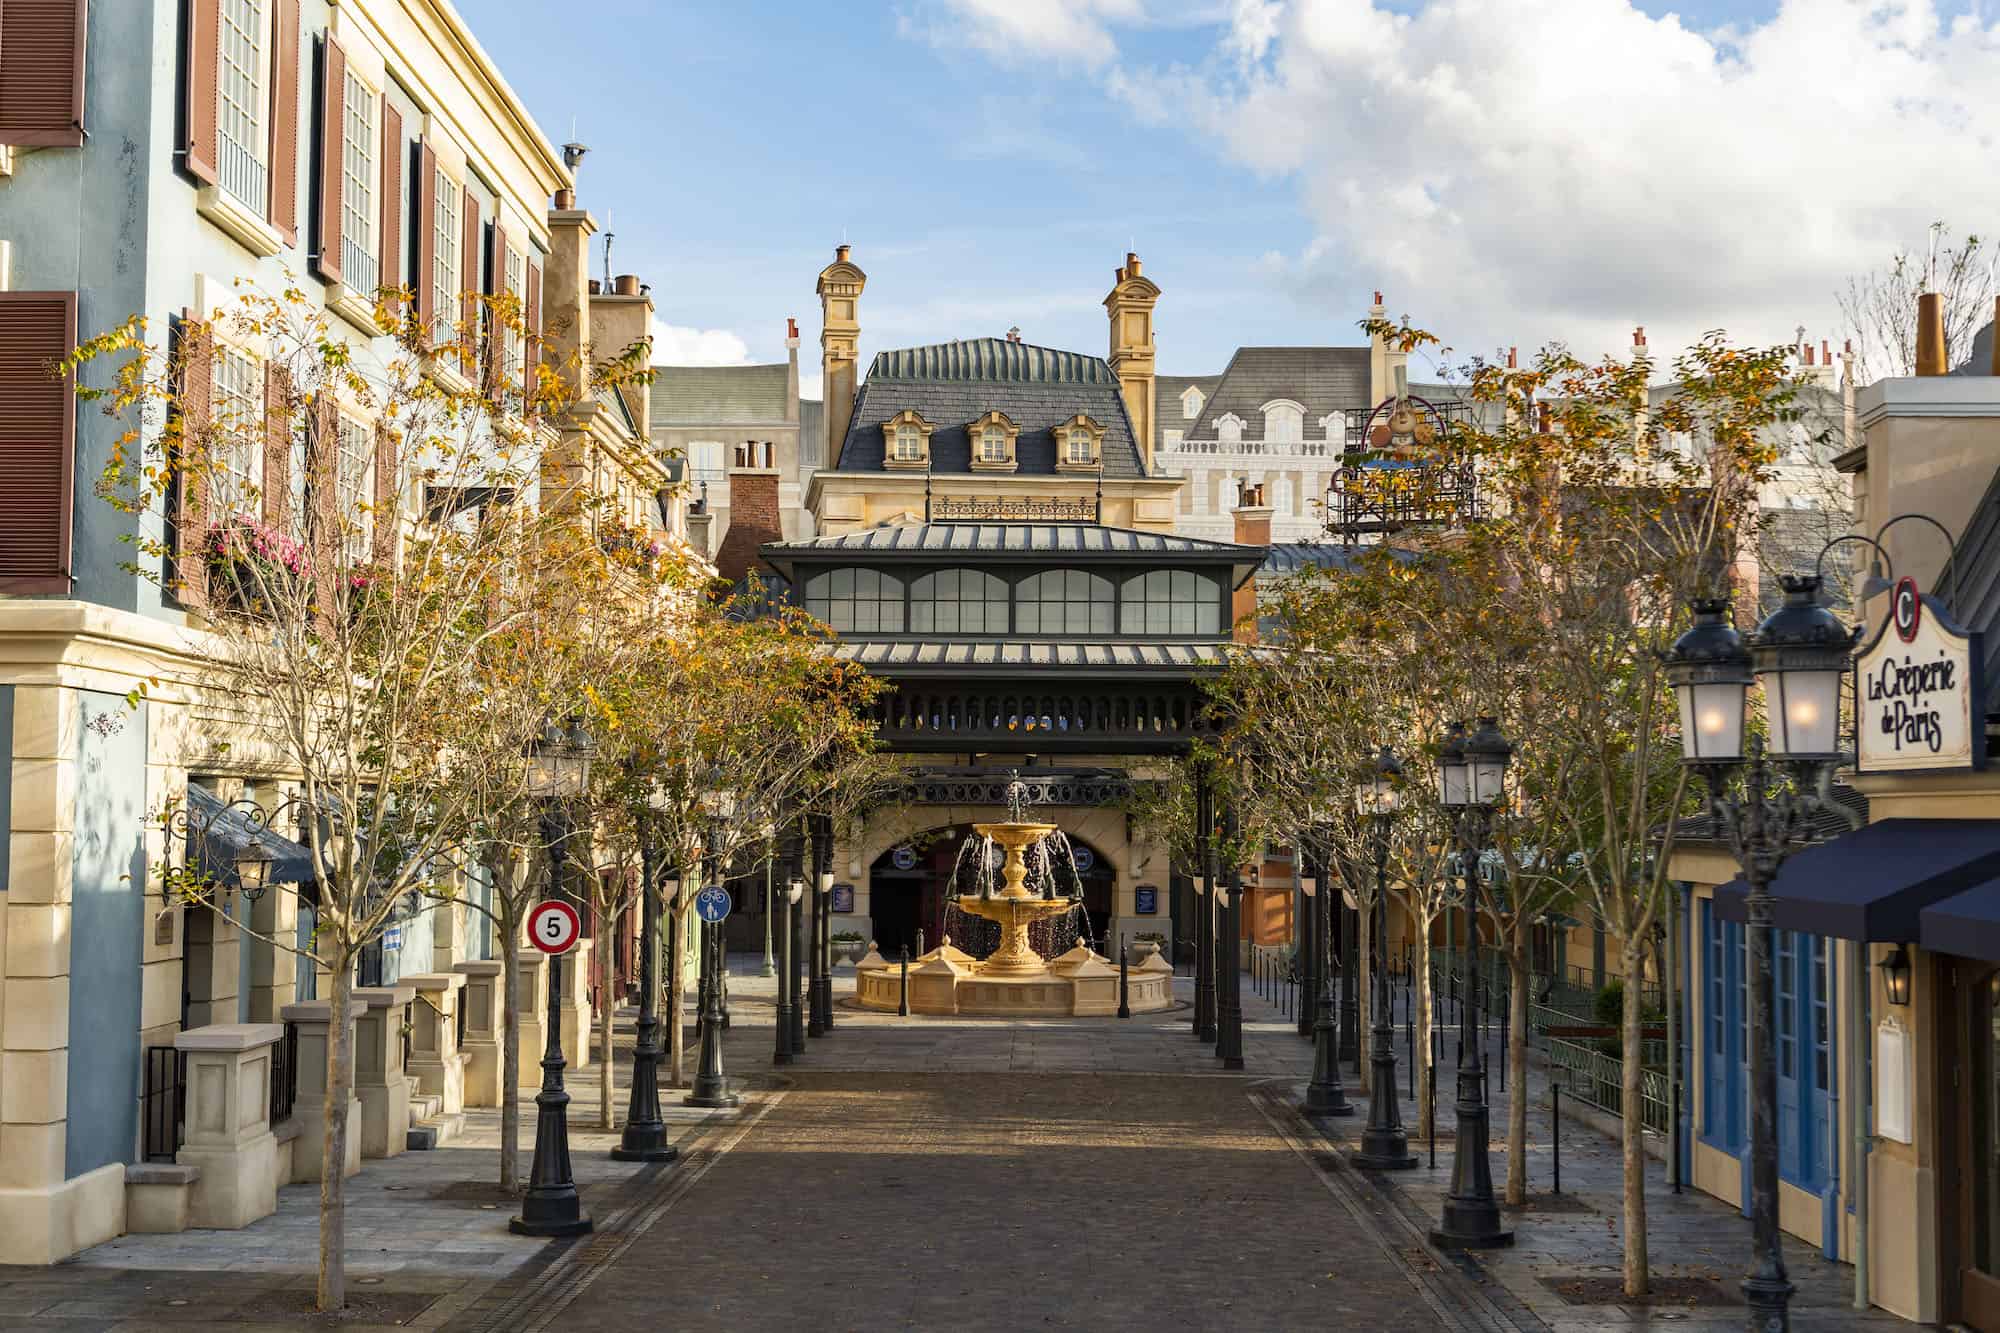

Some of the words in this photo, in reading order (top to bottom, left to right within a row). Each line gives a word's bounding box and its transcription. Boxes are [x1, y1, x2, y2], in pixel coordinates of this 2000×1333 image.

[1897, 591, 1912, 628] C
[1868, 673, 1882, 700] La
[1881, 650, 1955, 707] Crêperie
[1881, 705, 1895, 734] de
[1894, 700, 1941, 752] Paris
[546, 916, 560, 938] 5
